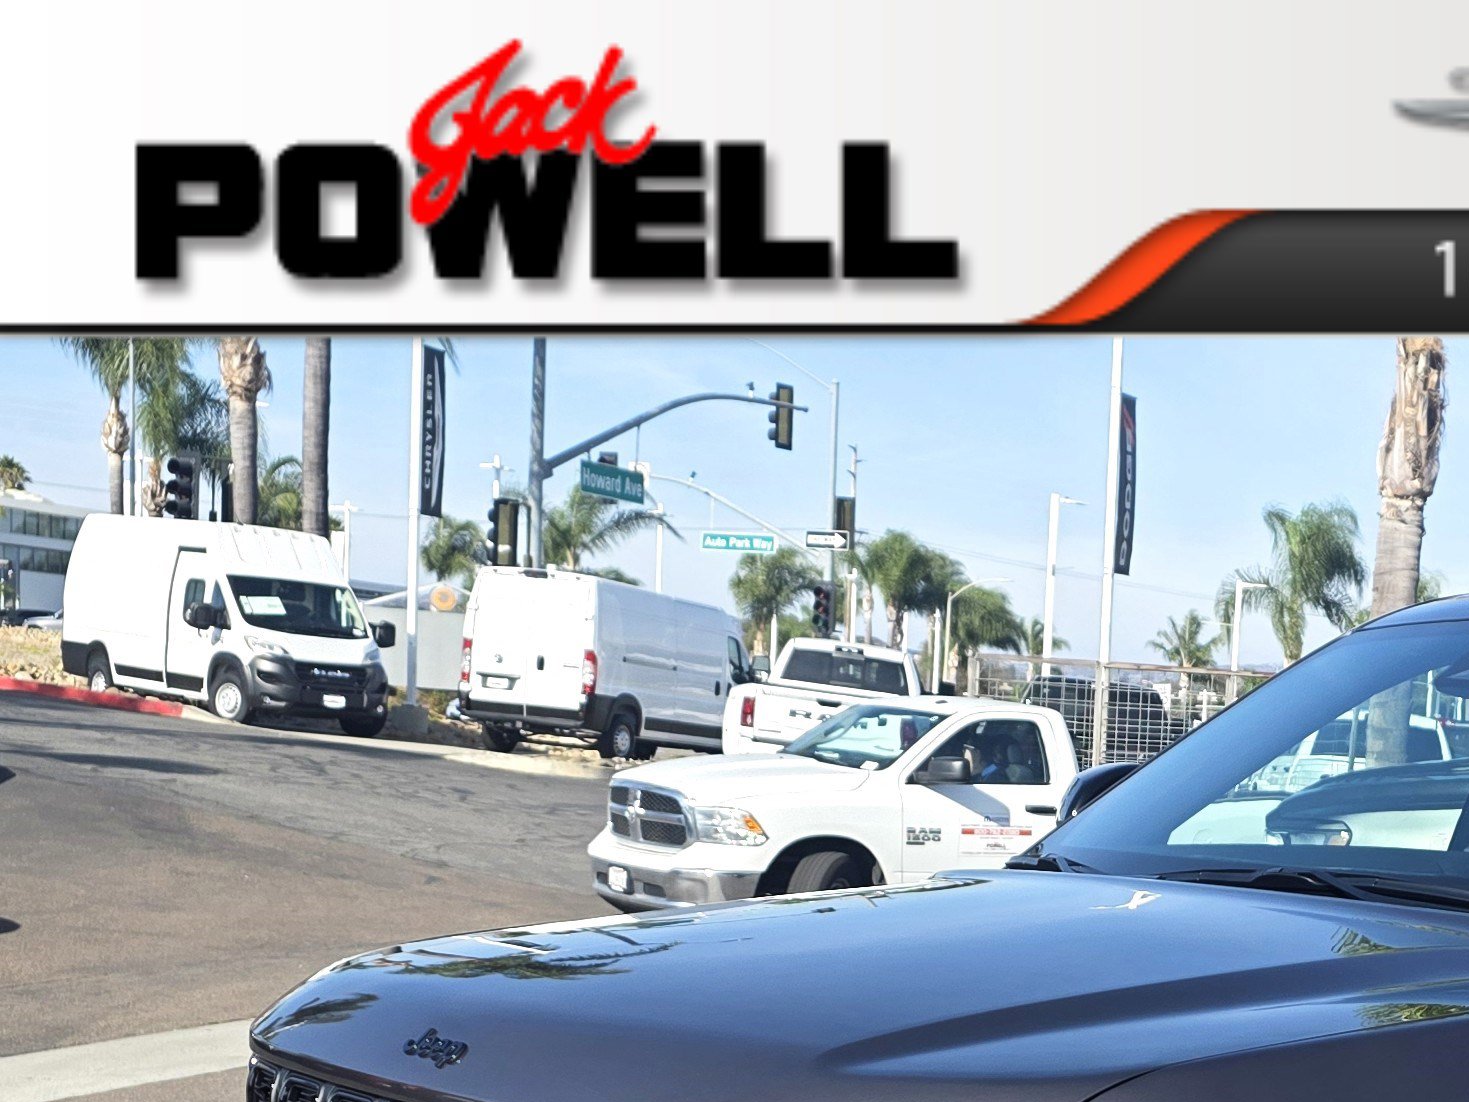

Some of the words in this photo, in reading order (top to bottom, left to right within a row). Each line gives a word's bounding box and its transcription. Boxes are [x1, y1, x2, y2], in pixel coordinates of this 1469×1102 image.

[424, 373, 434, 489] CHRYSLER
[581, 466, 622, 494] Howard
[624, 474, 643, 498] Ave
[703, 536, 727, 549] Auto
[729, 537, 751, 550] Park
[753, 538, 773, 551] Way
